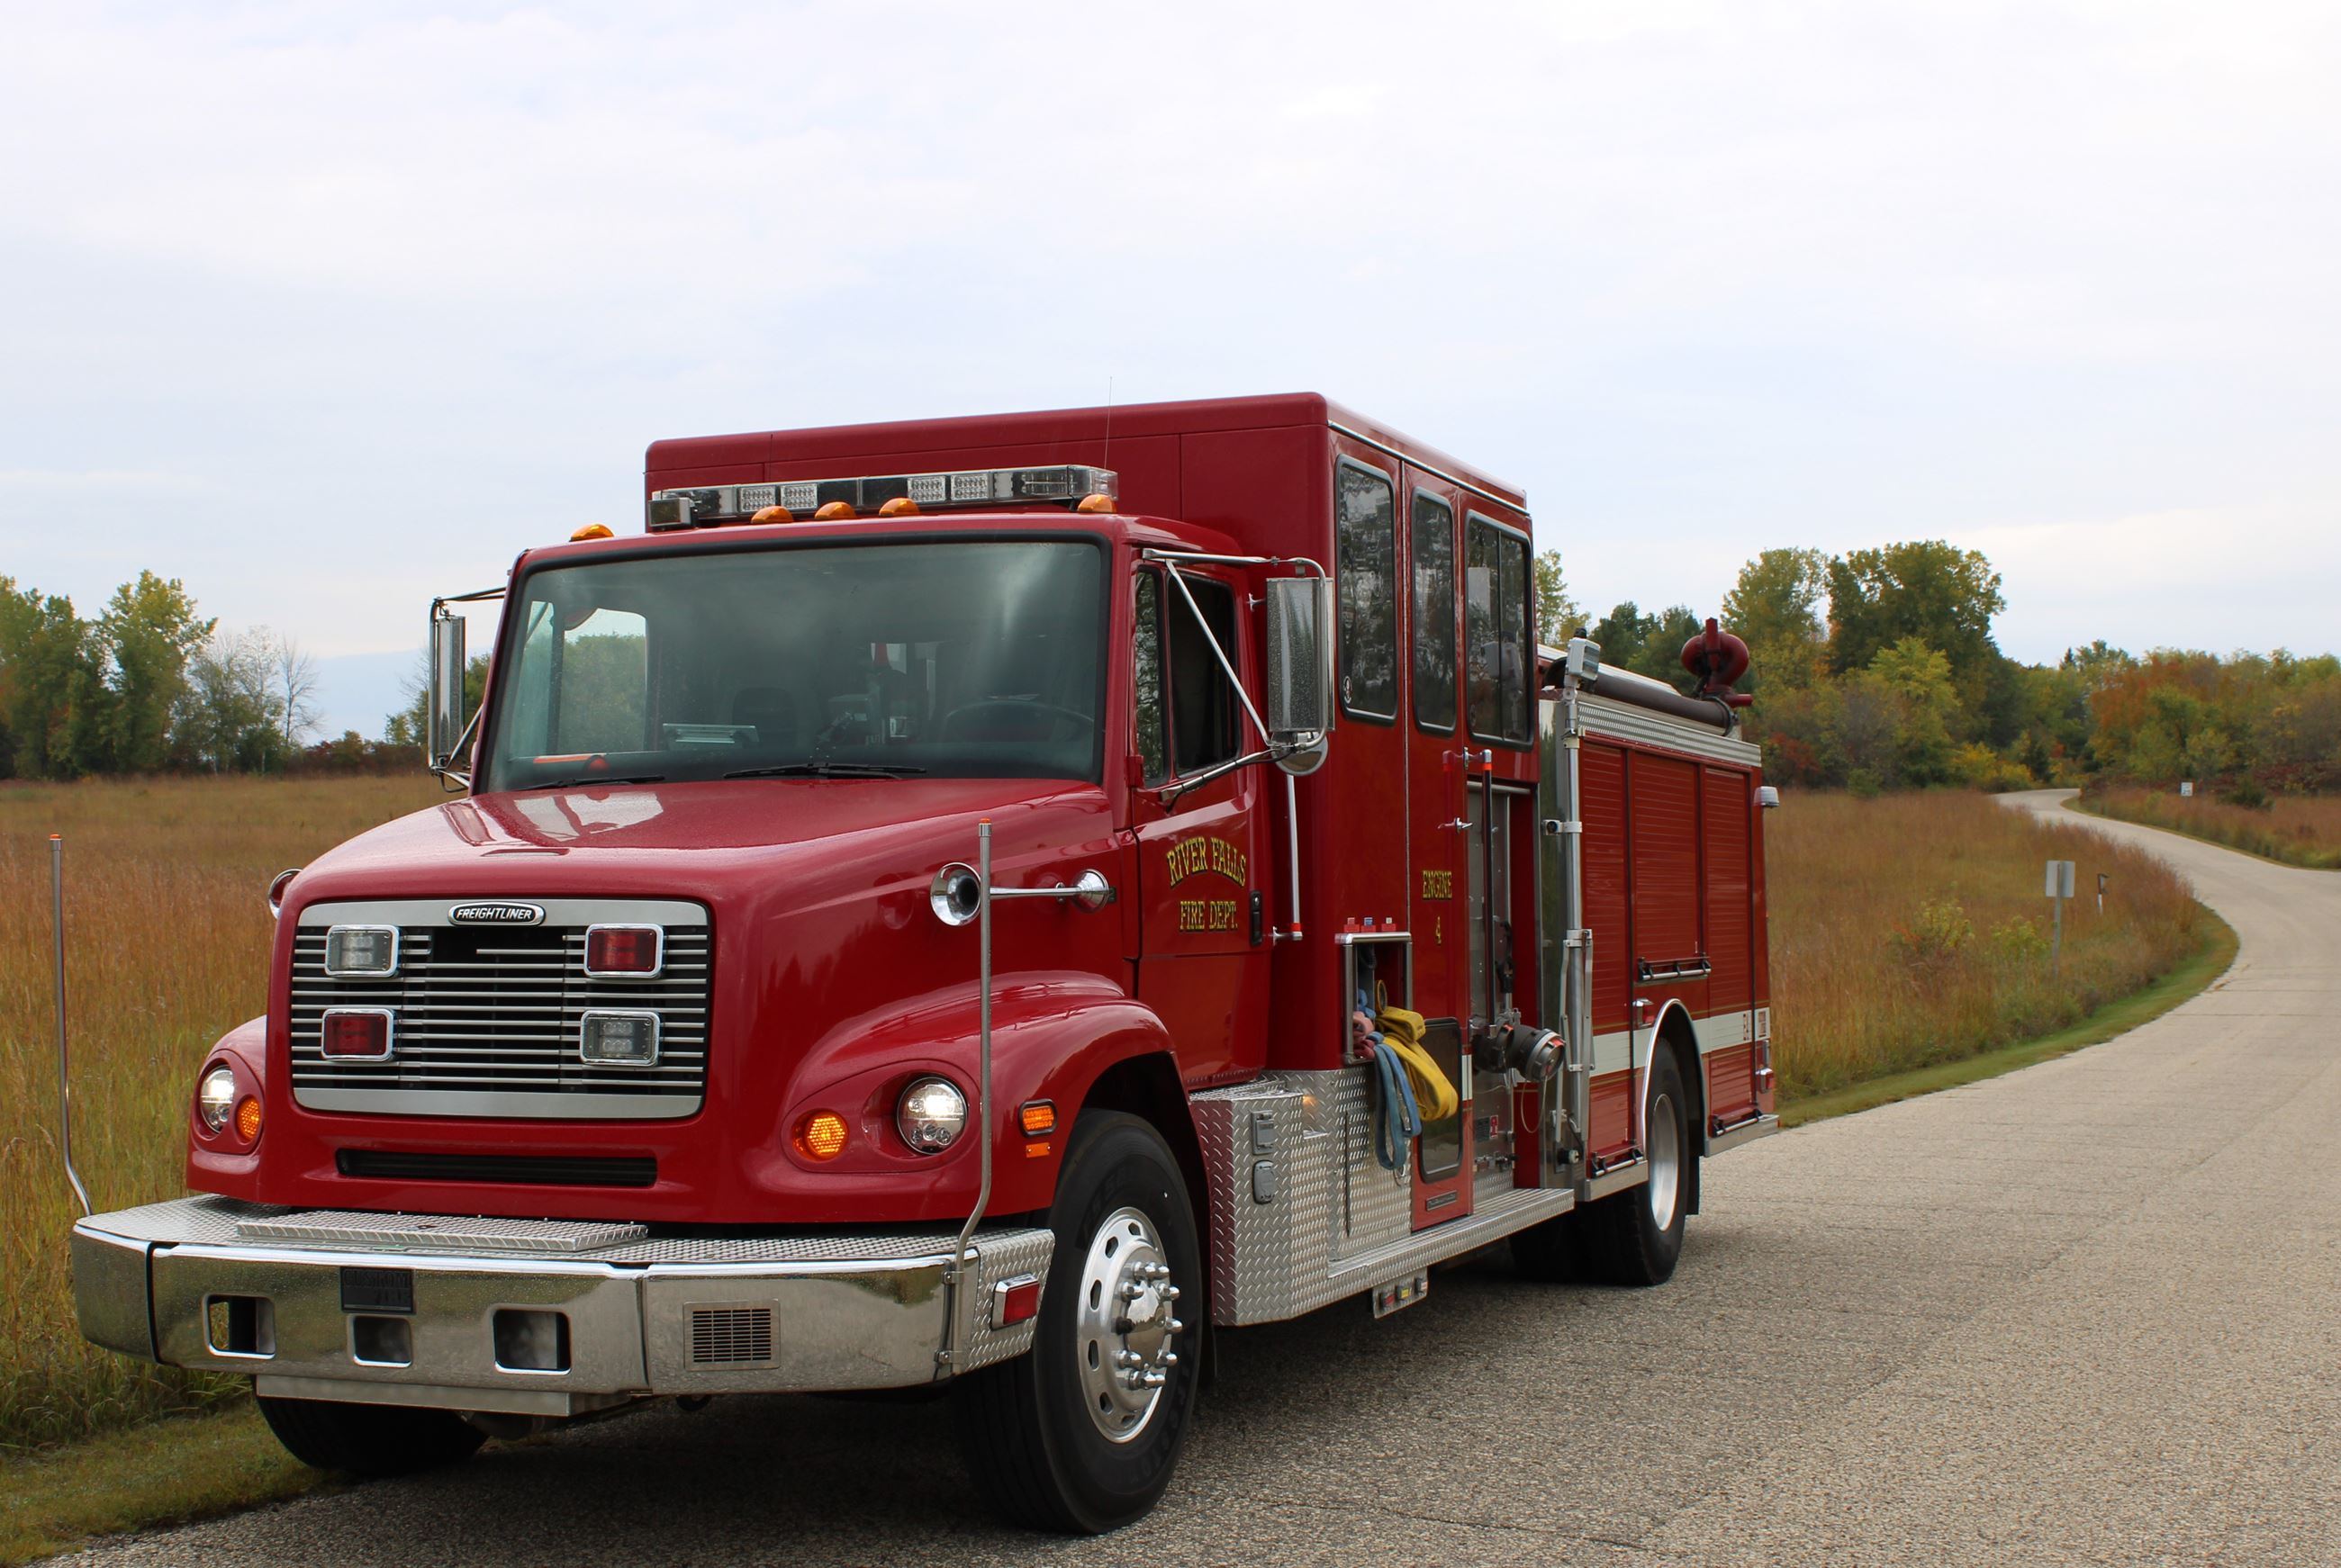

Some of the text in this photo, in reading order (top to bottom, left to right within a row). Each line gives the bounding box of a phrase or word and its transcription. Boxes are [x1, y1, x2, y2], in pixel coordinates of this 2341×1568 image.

[1167, 837, 1246, 888] RIVER FALLS
[1423, 870, 1452, 899] ENGINE
[456, 907, 532, 920] FREIGHTLINER
[1180, 901, 1238, 931] FIRE DEPT.
[1435, 915, 1442, 944] 4
